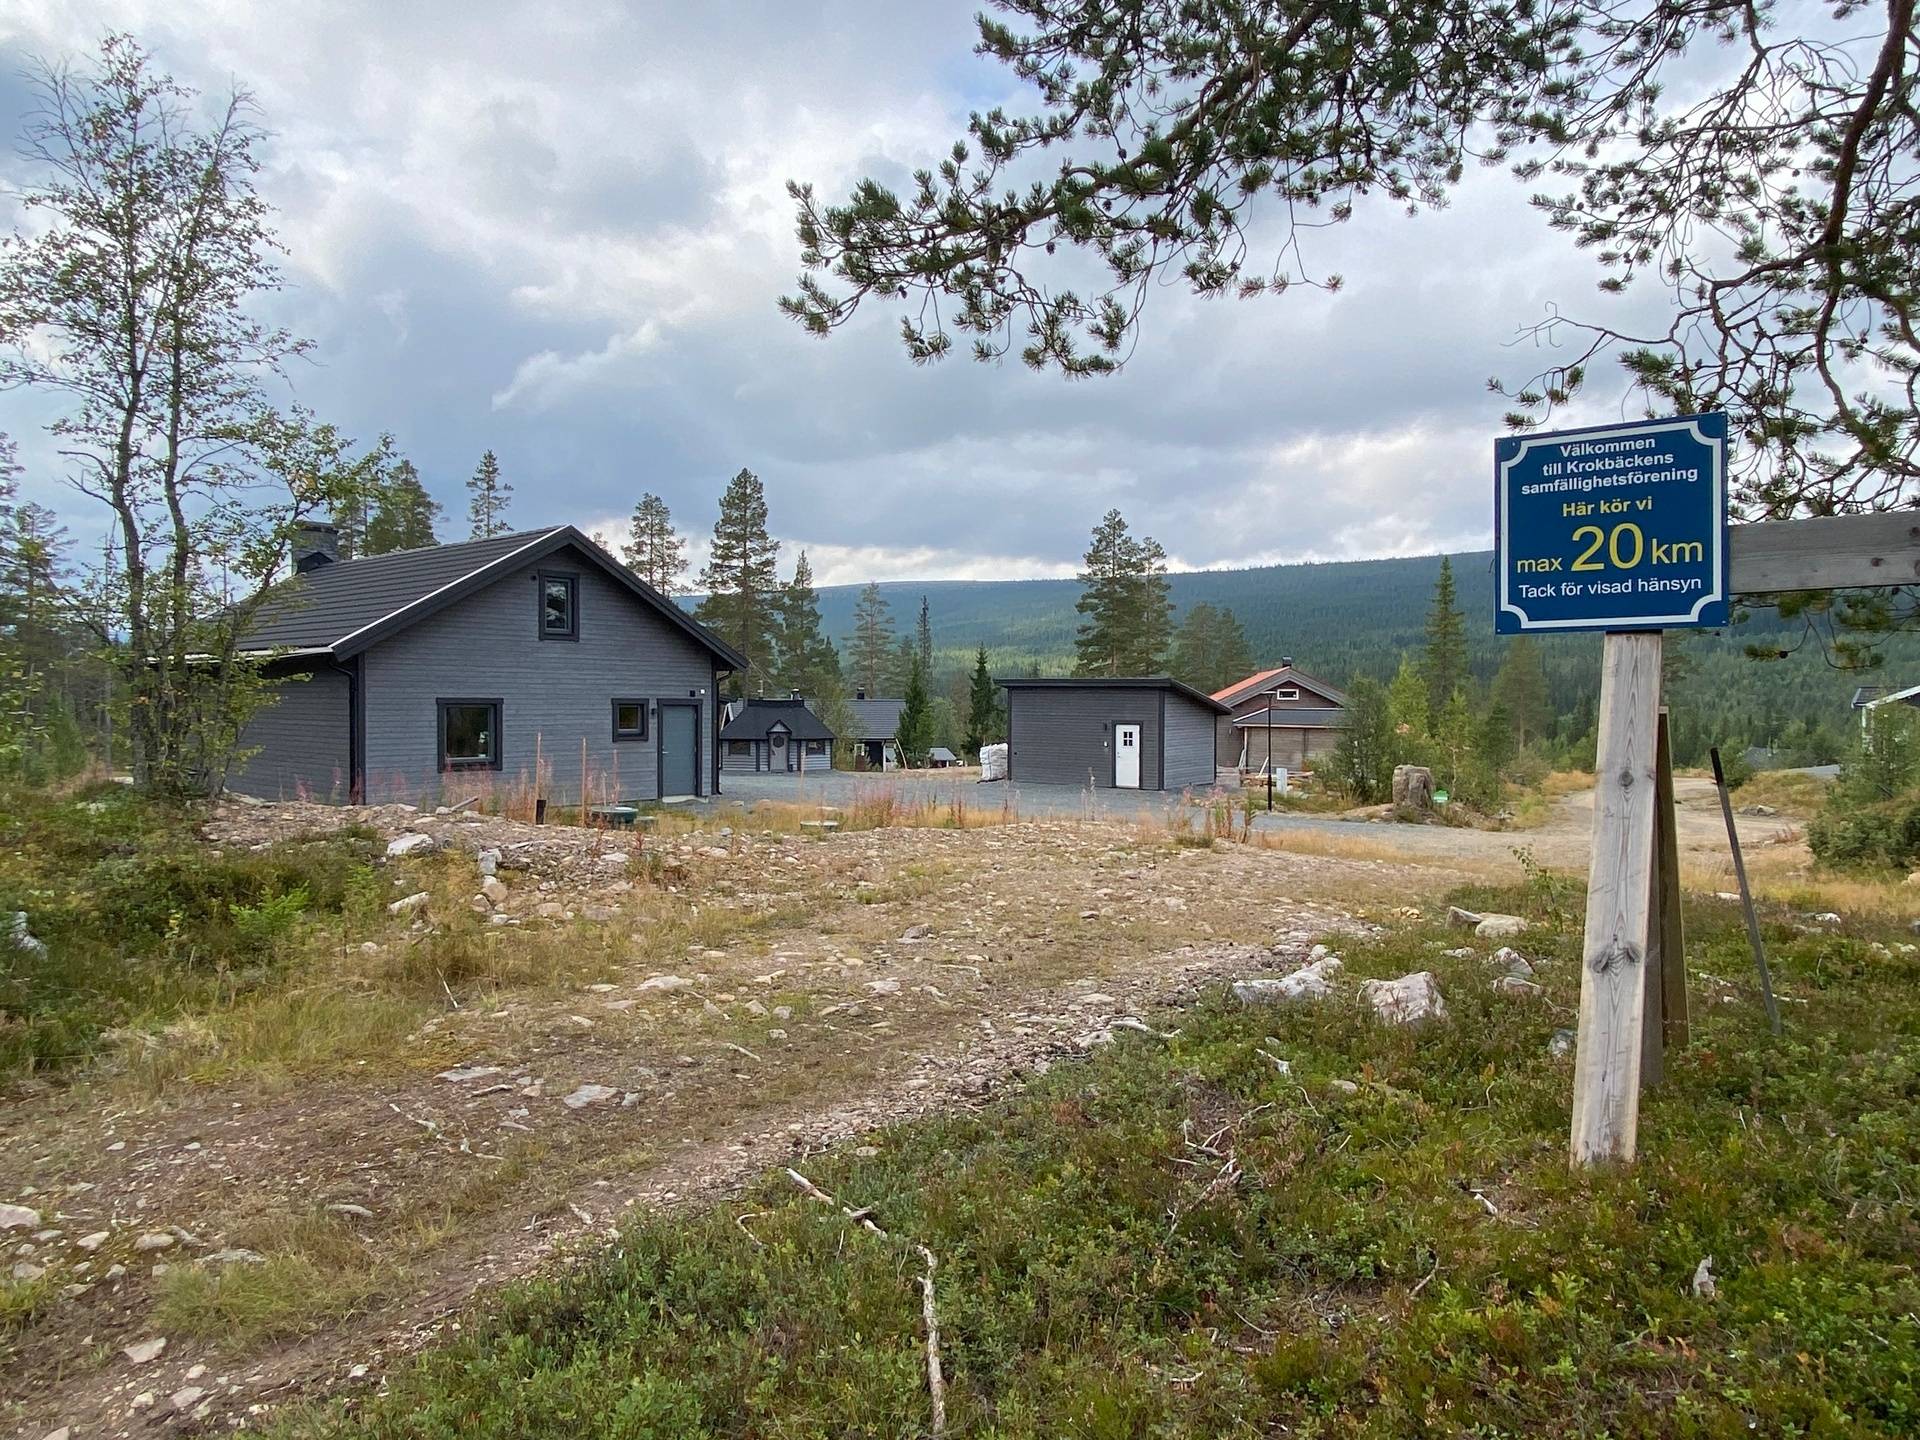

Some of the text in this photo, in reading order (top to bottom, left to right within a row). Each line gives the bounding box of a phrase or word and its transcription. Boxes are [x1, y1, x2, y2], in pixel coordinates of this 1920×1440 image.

[1560, 438, 1656, 458] Välkommen
[1542, 452, 1674, 476] till Krokbäckens
[1521, 468, 1698, 495] samfällighetsförening
[1563, 496, 1653, 517] Här kör vi
[1516, 522, 1703, 573] max 20 km
[1519, 577, 1702, 598] Tack för visad hänsyn
